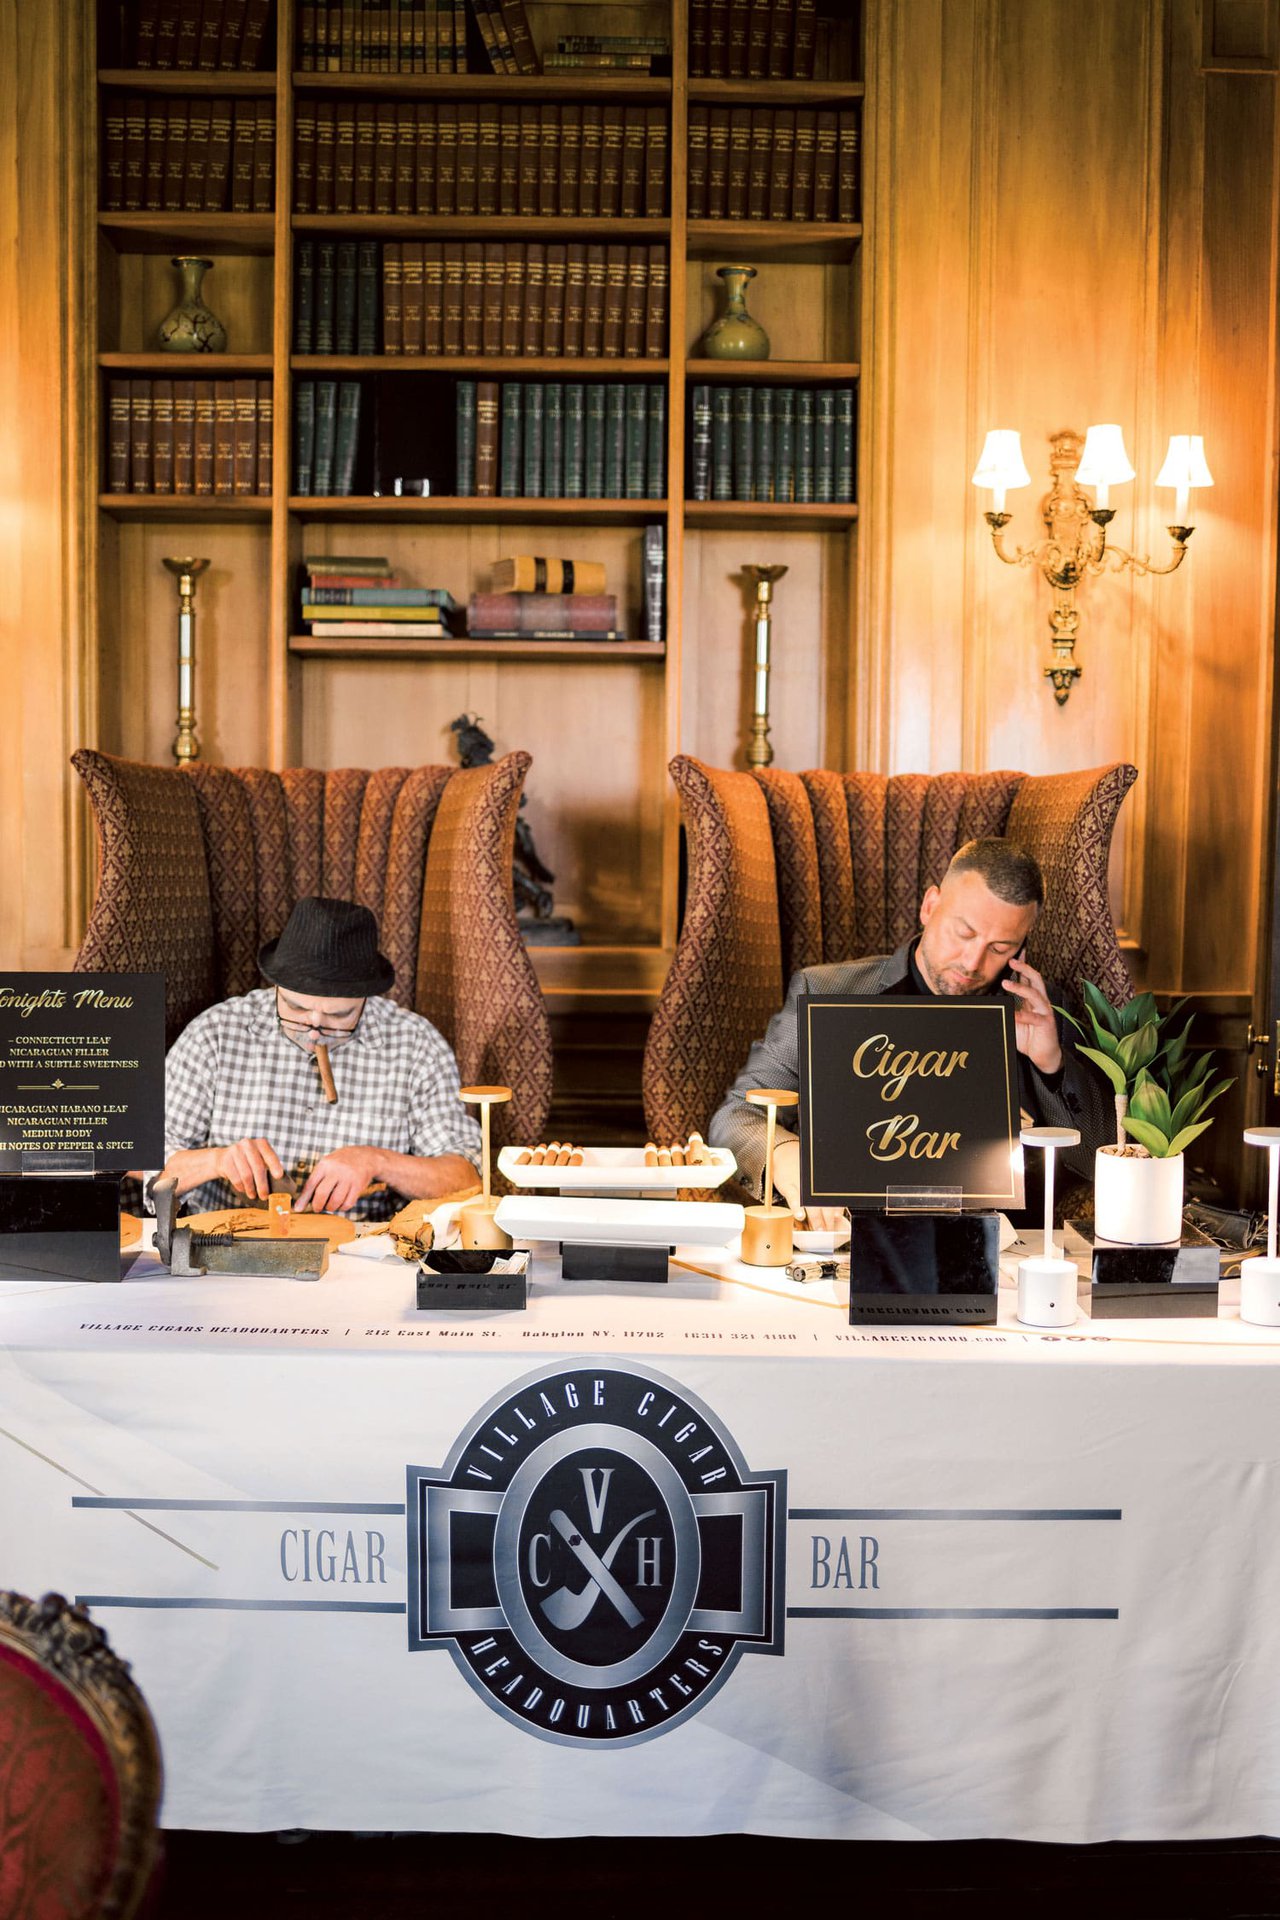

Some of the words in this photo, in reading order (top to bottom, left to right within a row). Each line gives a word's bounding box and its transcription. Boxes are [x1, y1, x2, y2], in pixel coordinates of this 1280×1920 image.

[73, 989, 134, 1009] Menu
[15, 1036, 85, 1045] CONNECTICUT
[86, 1036, 112, 1045] LEAF
[9, 1048, 73, 1057] NICARAGUAN
[75, 1048, 109, 1057] FILLER
[7, 1060, 34, 1069] WITH
[35, 1060, 43, 1069] A
[44, 1060, 82, 1069] SUBTLE
[83, 1060, 139, 1069] SWEETNESS
[852, 1033, 969, 1102] Cigar
[0, 1105, 58, 1114] ICARAGUAN
[60, 1105, 102, 1113] HABANO
[103, 1104, 129, 1113] LEAF
[7, 1117, 71, 1126] NICARAGUAN
[73, 1117, 108, 1125] FILLER
[22, 1129, 64, 1138] MEDIUM
[65, 1129, 93, 1138] BODY
[866, 1114, 961, 1162] Bar
[8, 1141, 41, 1150] NOTES
[42, 1141, 57, 1150] OF
[57, 1141, 95, 1150] PEPPER
[96, 1141, 104, 1150] &
[105, 1141, 134, 1150] SPICE
[79, 1323, 143, 1331] VILLAGE
[148, 1324, 204, 1332] CIGARS
[209, 1326, 330, 1335] HEADQUARTERS
[522, 1330, 585, 1338] Babylon
[466, 1379, 605, 1482] VILLAGE
[637, 1391, 729, 1487] CIGAR
[578, 1467, 616, 1534] V
[280, 1528, 388, 1585] CIGAR
[810, 1535, 881, 1590] BAR
[528, 1532, 553, 1588] C
[637, 1536, 663, 1588] H
[469, 1636, 724, 1731] HEADQUARTERS
